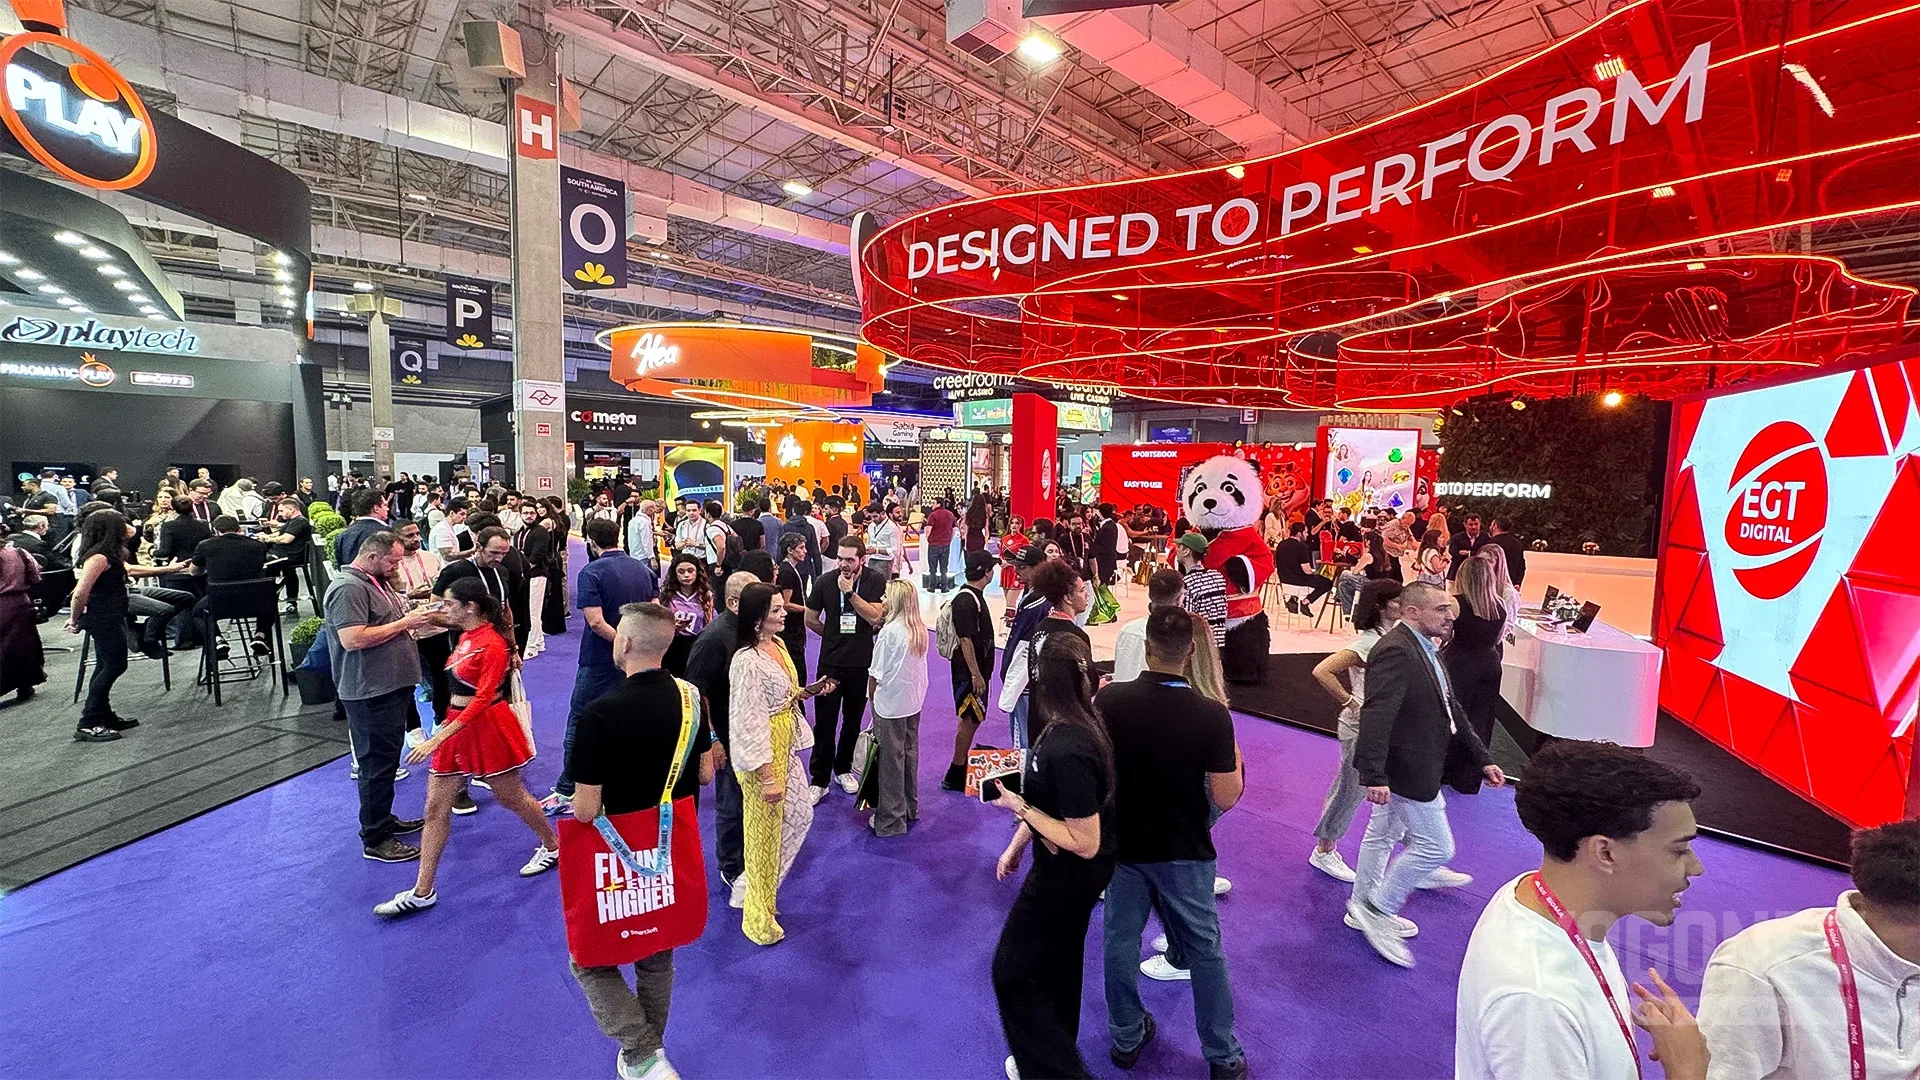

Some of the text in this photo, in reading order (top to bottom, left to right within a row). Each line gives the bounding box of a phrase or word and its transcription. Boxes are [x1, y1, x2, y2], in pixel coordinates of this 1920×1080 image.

[6, 63, 143, 154] PLAY
[521, 108, 553, 151] H
[908, 41, 1712, 280] DESIGNED TO PERFORM
[567, 177, 590, 189] SOUTH
[590, 184, 618, 196] AMERICA
[569, 203, 616, 254] O
[456, 298, 482, 327] P
[60, 320, 197, 351] playtech
[400, 350, 422, 373] Q
[933, 371, 1015, 389] creedroomz
[968, 388, 993, 397] CASINO
[1070, 392, 1110, 404] LIVE CASINO
[571, 411, 636, 425] cometa
[1244, 409, 1255, 421] E
[893, 430, 914, 438] Gaming
[1449, 482, 1463, 495] TO
[1464, 483, 1551, 498] PERFORM
[1742, 481, 1806, 521] EGT
[1740, 523, 1793, 543] DIGITAL
[597, 884, 676, 925] HIGHER
[630, 926, 658, 936] SmartSoft
